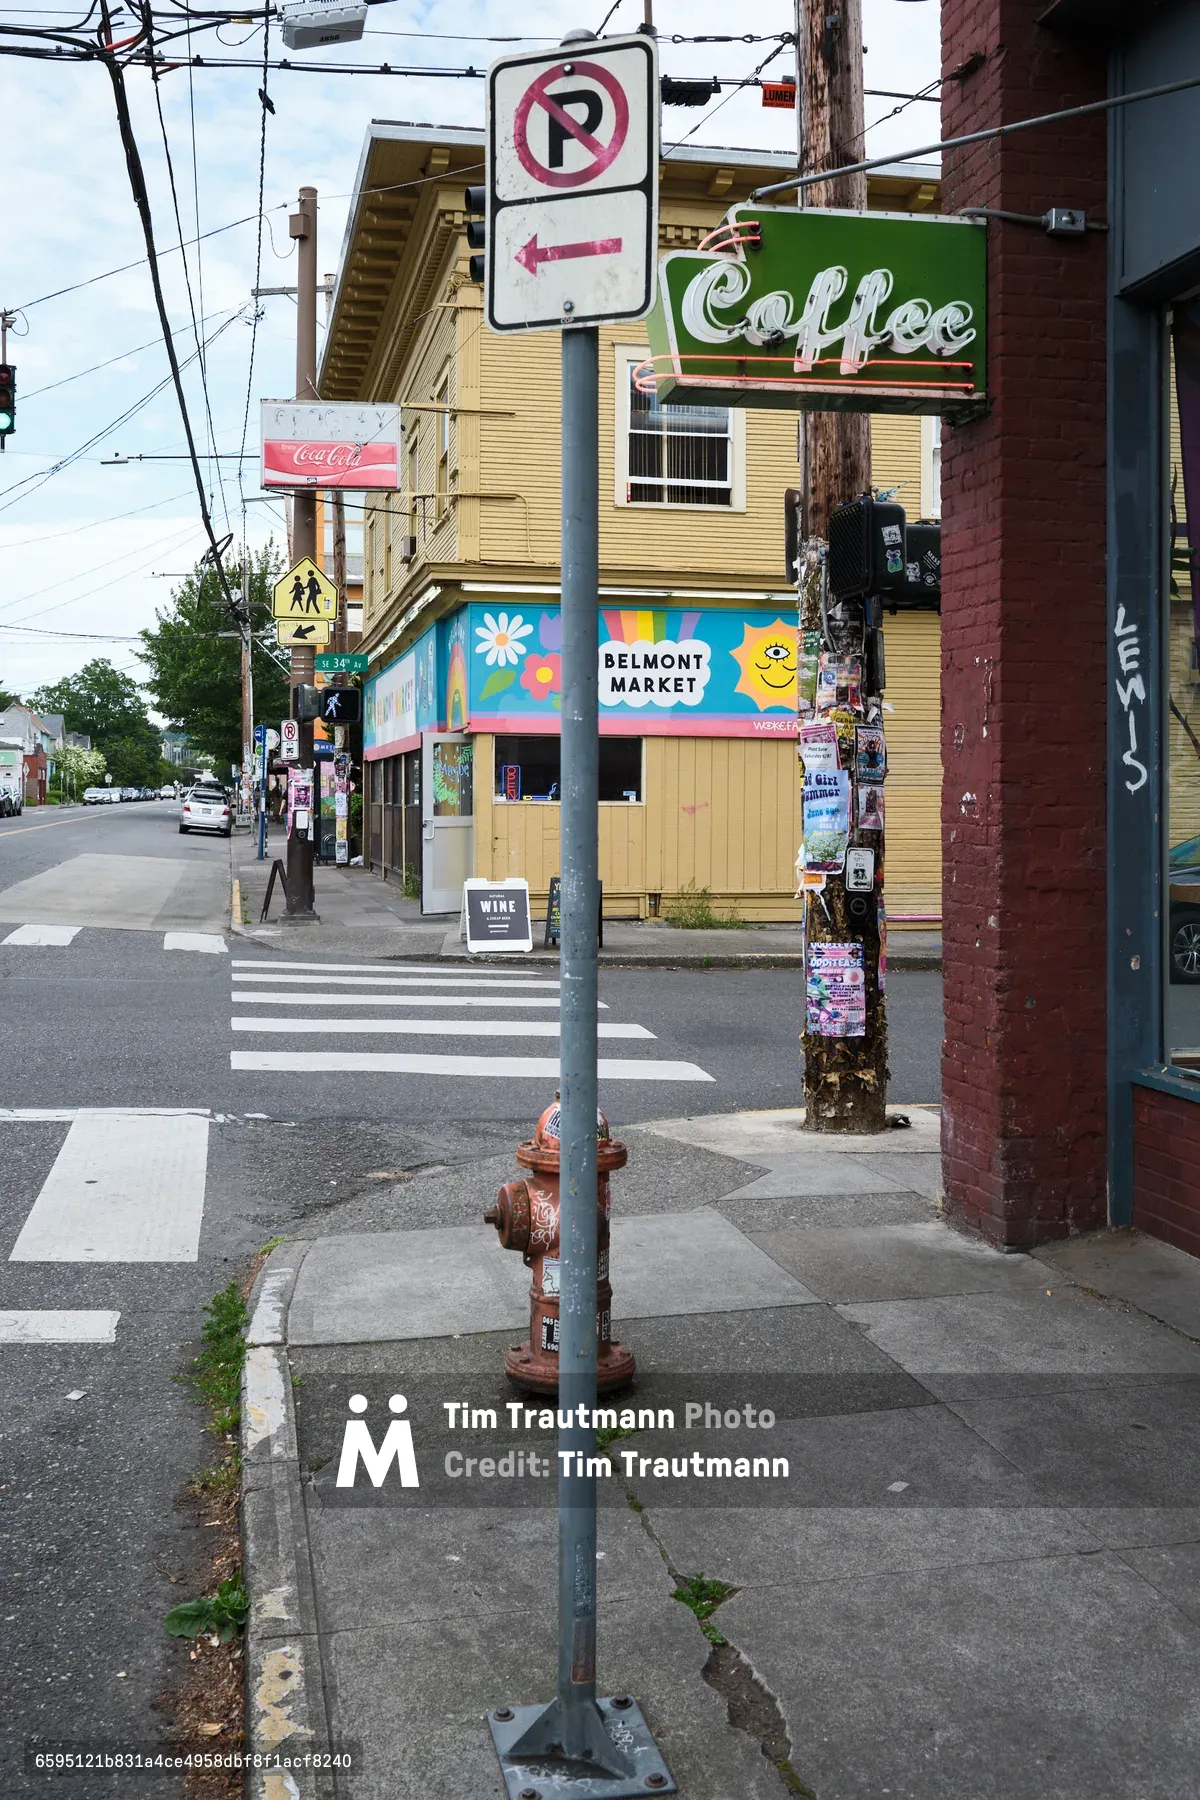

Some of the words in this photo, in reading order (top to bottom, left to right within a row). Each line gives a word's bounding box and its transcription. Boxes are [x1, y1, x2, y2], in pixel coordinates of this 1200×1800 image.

[763, 90, 796, 103] LUMEN
[681, 258, 977, 376] Coffee
[281, 443, 297, 451] Enjoy
[321, 660, 330, 668] SE
[333, 658, 351, 668] 34th
[353, 661, 362, 669] Av
[604, 653, 703, 670] BELMONT
[610, 676, 696, 693] MARKET
[1114, 603, 1148, 794] LEWIS
[507, 766, 517, 800] OPEN
[815, 773, 839, 786] Girl
[480, 900, 516, 913] WINE
